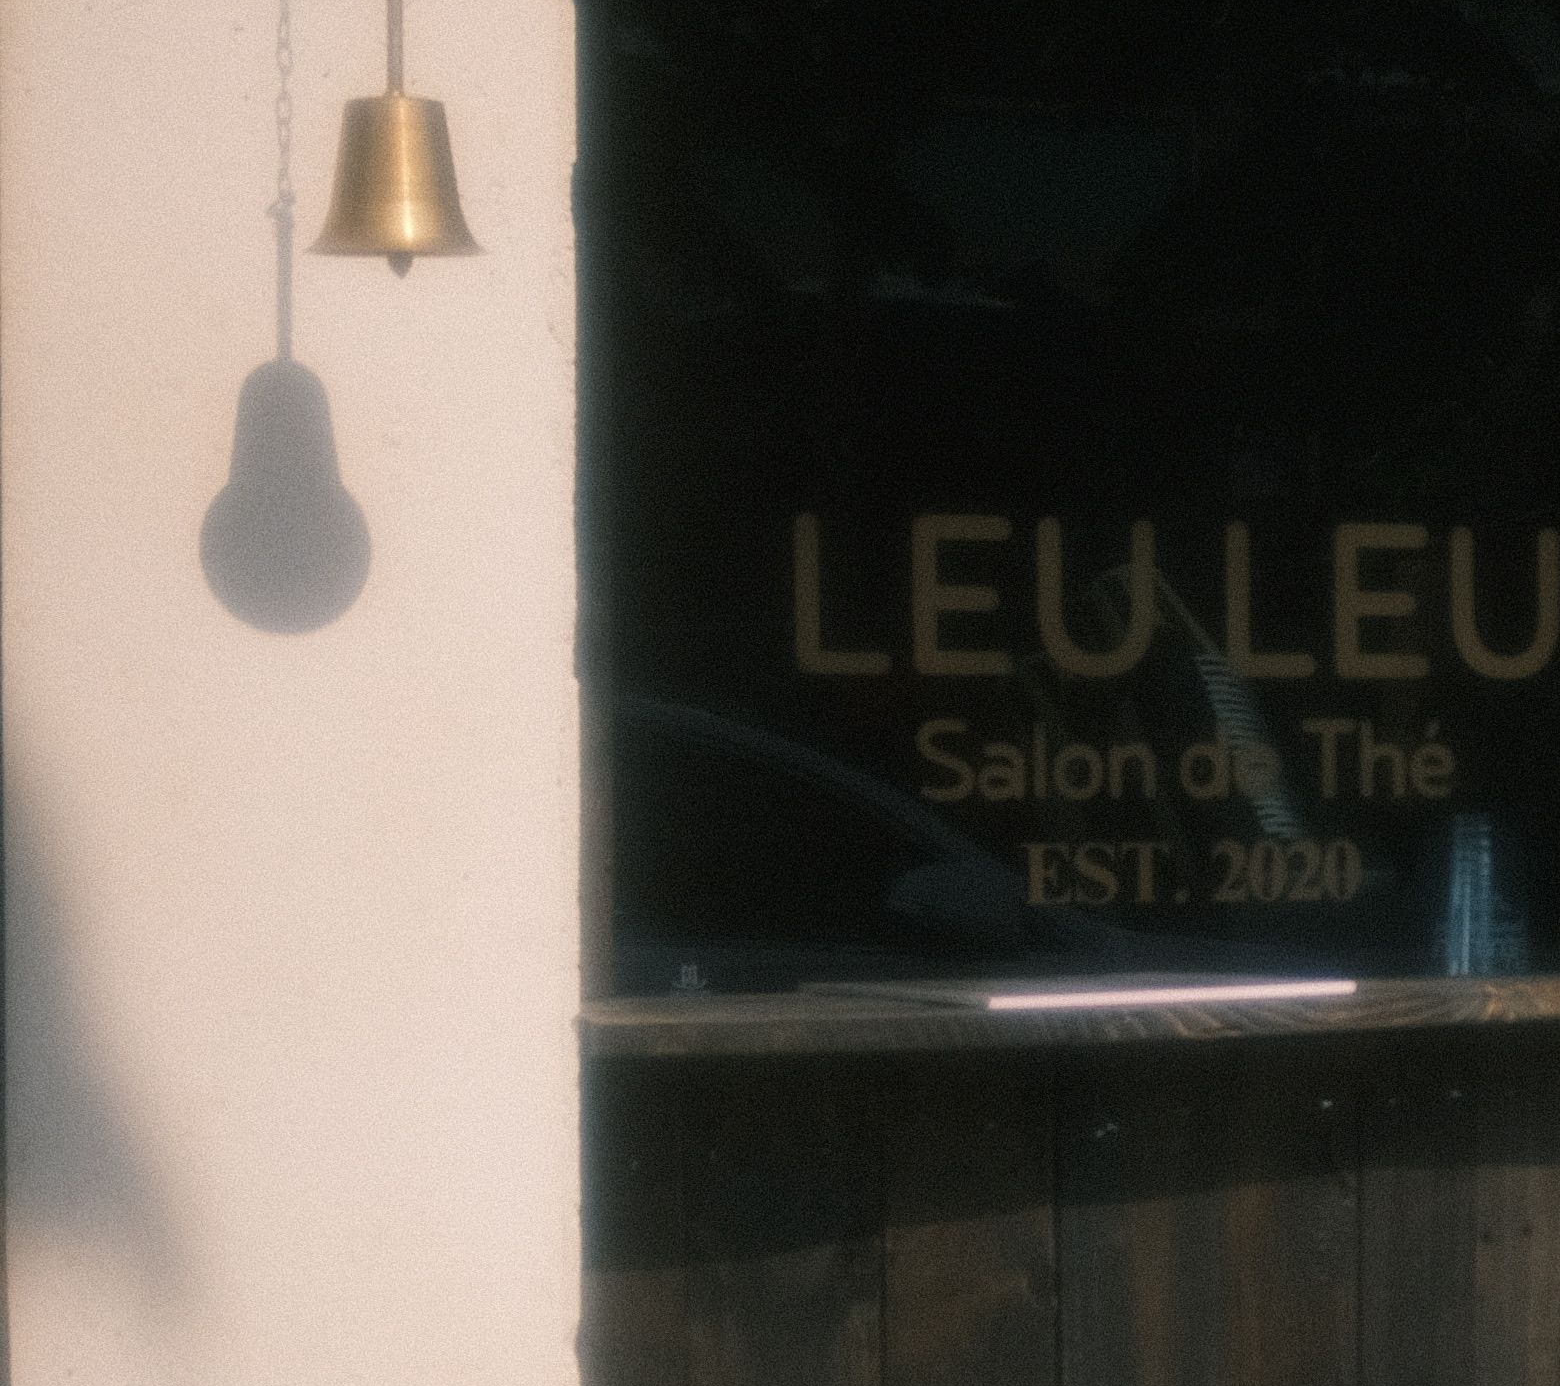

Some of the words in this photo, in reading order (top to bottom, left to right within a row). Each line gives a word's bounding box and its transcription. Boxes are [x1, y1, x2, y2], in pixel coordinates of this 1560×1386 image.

[797, 512, 1158, 681] LEU
[914, 717, 1157, 802] Salon
[1180, 721, 1283, 801] de
[1303, 715, 1457, 802] Thé
[1023, 840, 1189, 906] EST.
[1213, 839, 1364, 906] 2020
